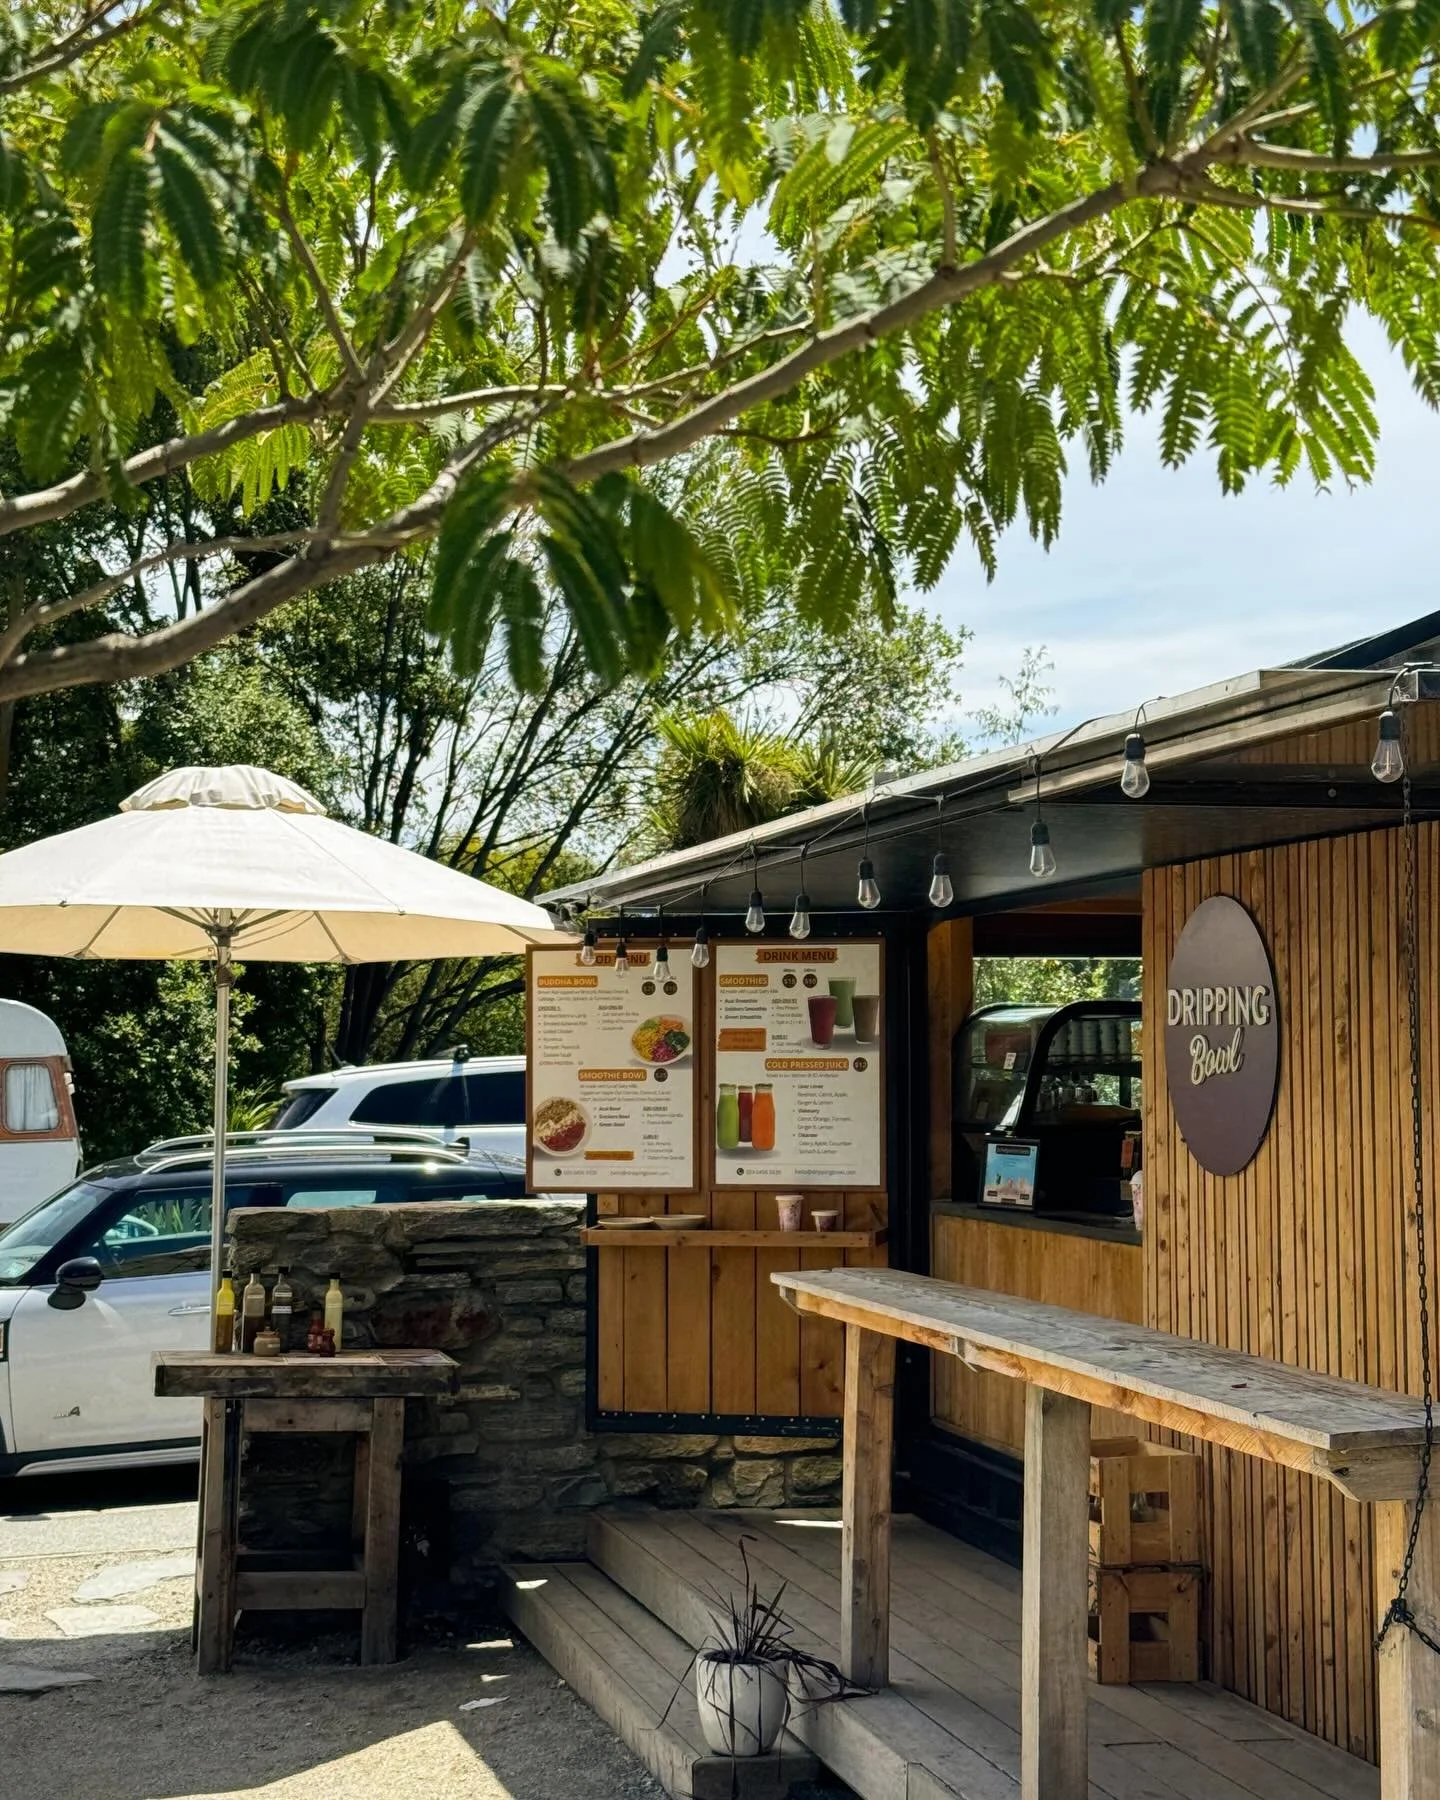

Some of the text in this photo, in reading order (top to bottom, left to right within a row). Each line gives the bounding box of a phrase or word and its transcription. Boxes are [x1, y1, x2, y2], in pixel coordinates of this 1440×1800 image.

[763, 951, 835, 961] DRINK MENU
[539, 978, 597, 986] BUDDHA BOWL
[720, 976, 767, 985] SMOOTHIES
[1167, 985, 1269, 1026] DRIPPING
[1189, 1028, 1245, 1086] Bowl
[766, 1061, 847, 1070] COLD PRESSED JUICE
[579, 1071, 645, 1080] SMOOTHIE BOWL
